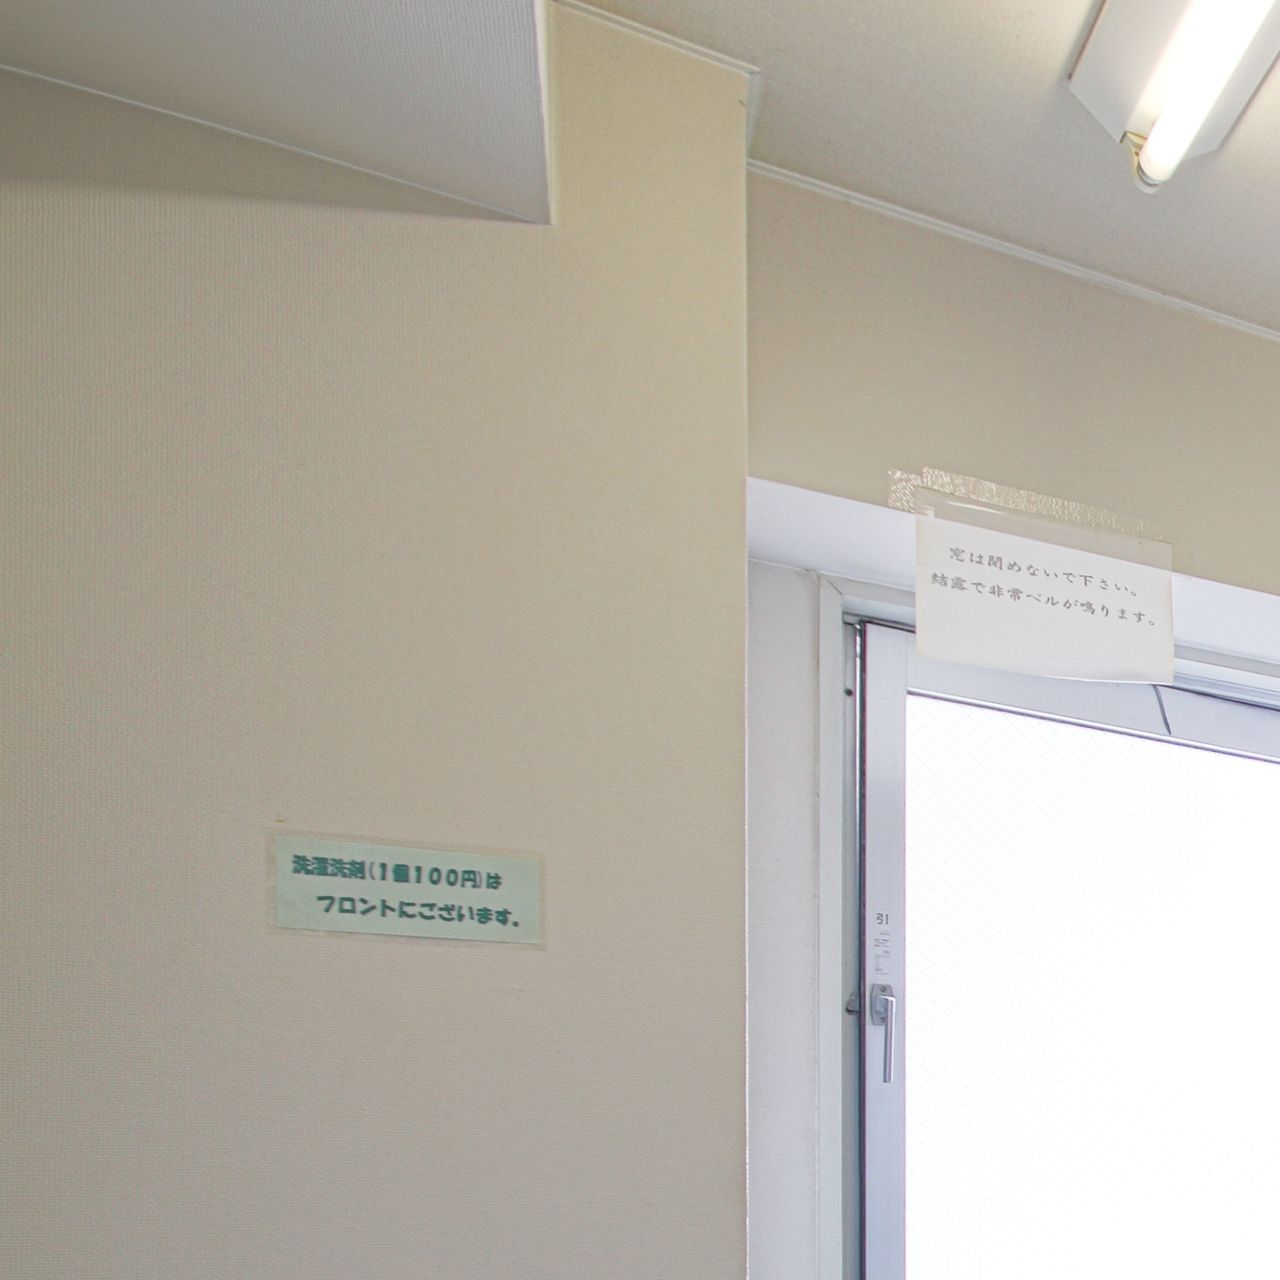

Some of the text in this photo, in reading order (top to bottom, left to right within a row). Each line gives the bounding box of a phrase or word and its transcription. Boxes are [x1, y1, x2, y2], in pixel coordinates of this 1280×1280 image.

[930, 571, 1156, 627] 結露で非常ベルが鳴ります。
[316, 894, 520, 928] フロントにございます。
